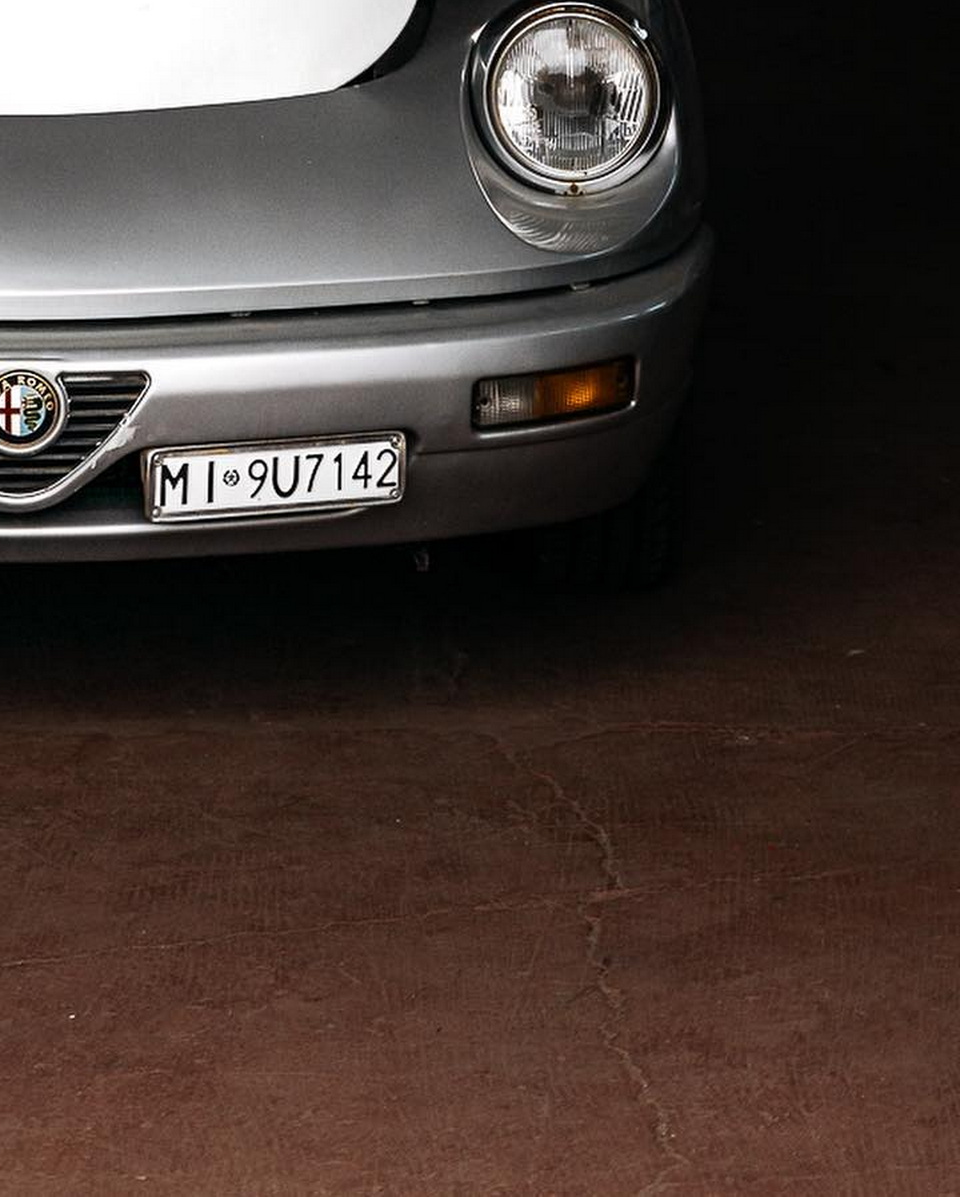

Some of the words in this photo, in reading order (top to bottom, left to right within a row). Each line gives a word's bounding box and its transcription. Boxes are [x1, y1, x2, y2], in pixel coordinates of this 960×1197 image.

[16, 375, 54, 411] ROMEO
[160, 460, 214, 507] MI
[248, 448, 397, 499] 9U7142
